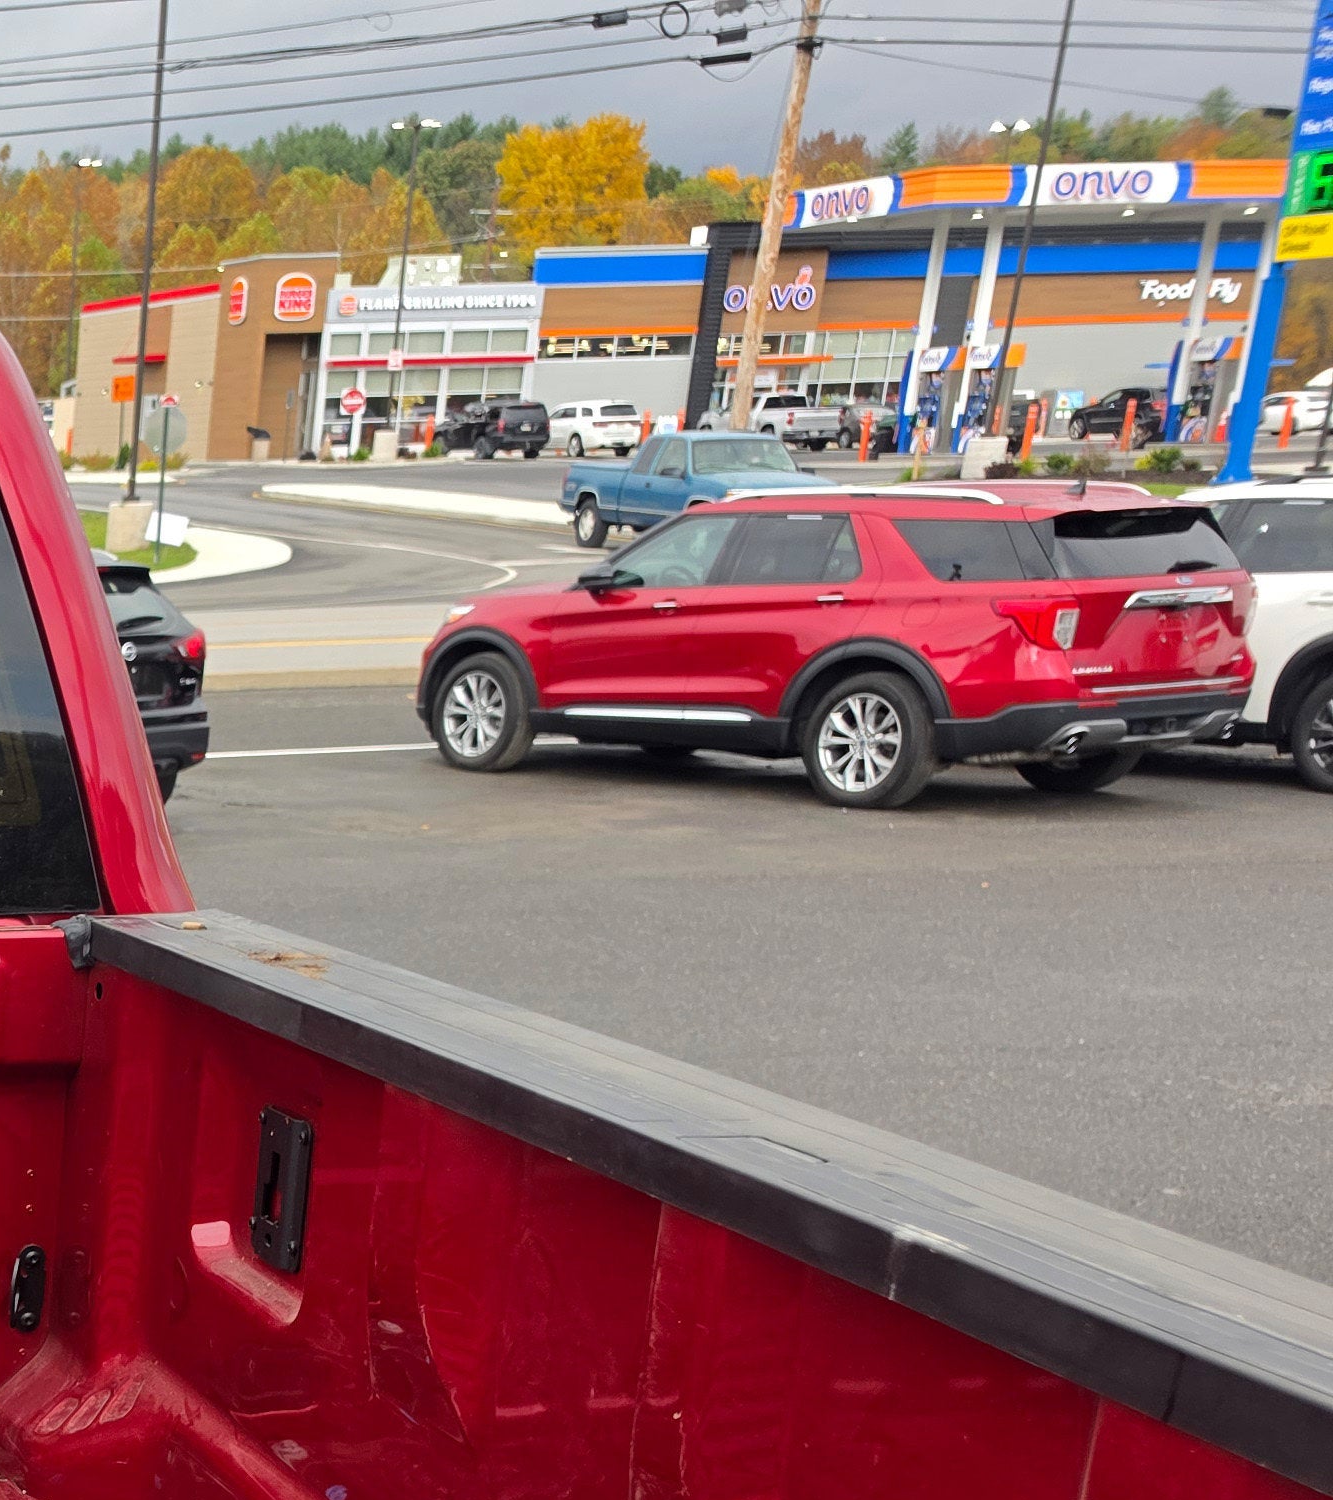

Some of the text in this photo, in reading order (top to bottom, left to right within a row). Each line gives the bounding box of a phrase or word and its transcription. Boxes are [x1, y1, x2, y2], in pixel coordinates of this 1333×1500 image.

[1053, 169, 1154, 198] onvo
[810, 184, 871, 220] onvo
[1140, 278, 1197, 300] Food
[278, 299, 312, 312] KING
[465, 295, 505, 309] SINCE
